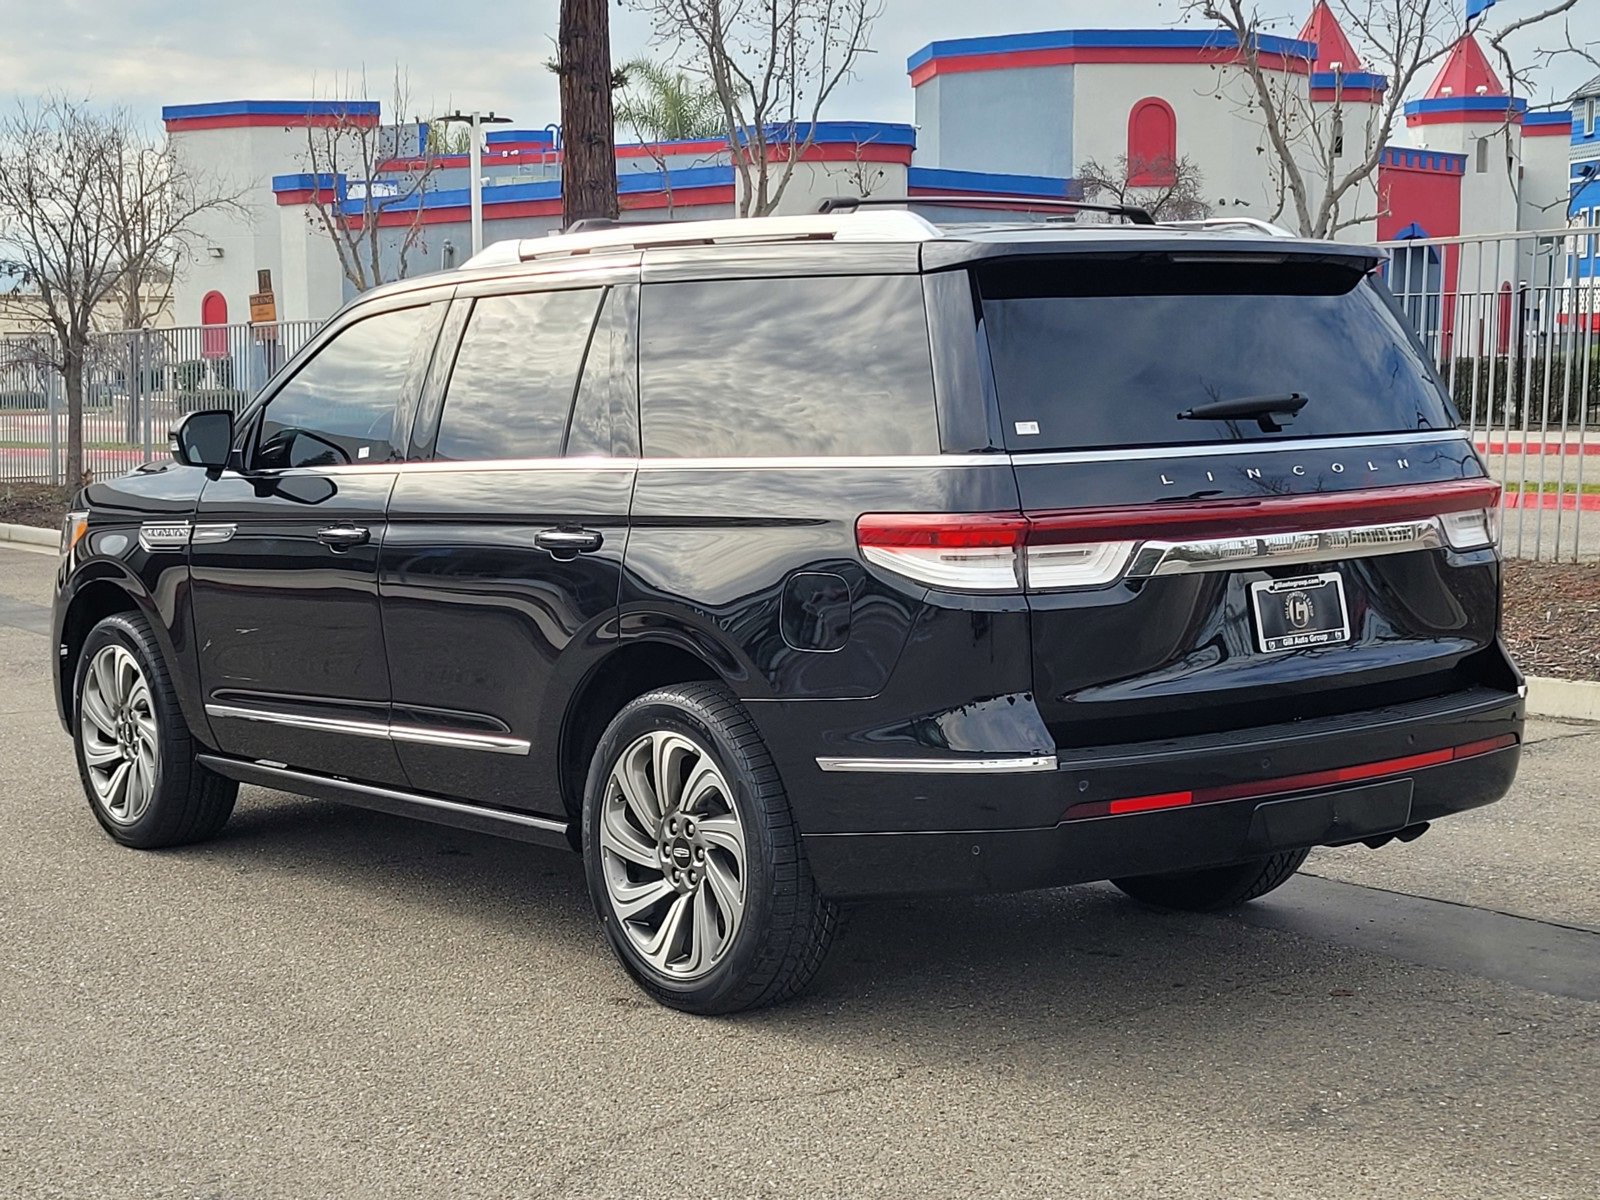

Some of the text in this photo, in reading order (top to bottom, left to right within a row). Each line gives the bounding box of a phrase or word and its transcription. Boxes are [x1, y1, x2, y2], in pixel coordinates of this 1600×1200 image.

[1160, 458, 1409, 485] LINCOLN
[1282, 634, 1328, 646] Gill Auto Group
